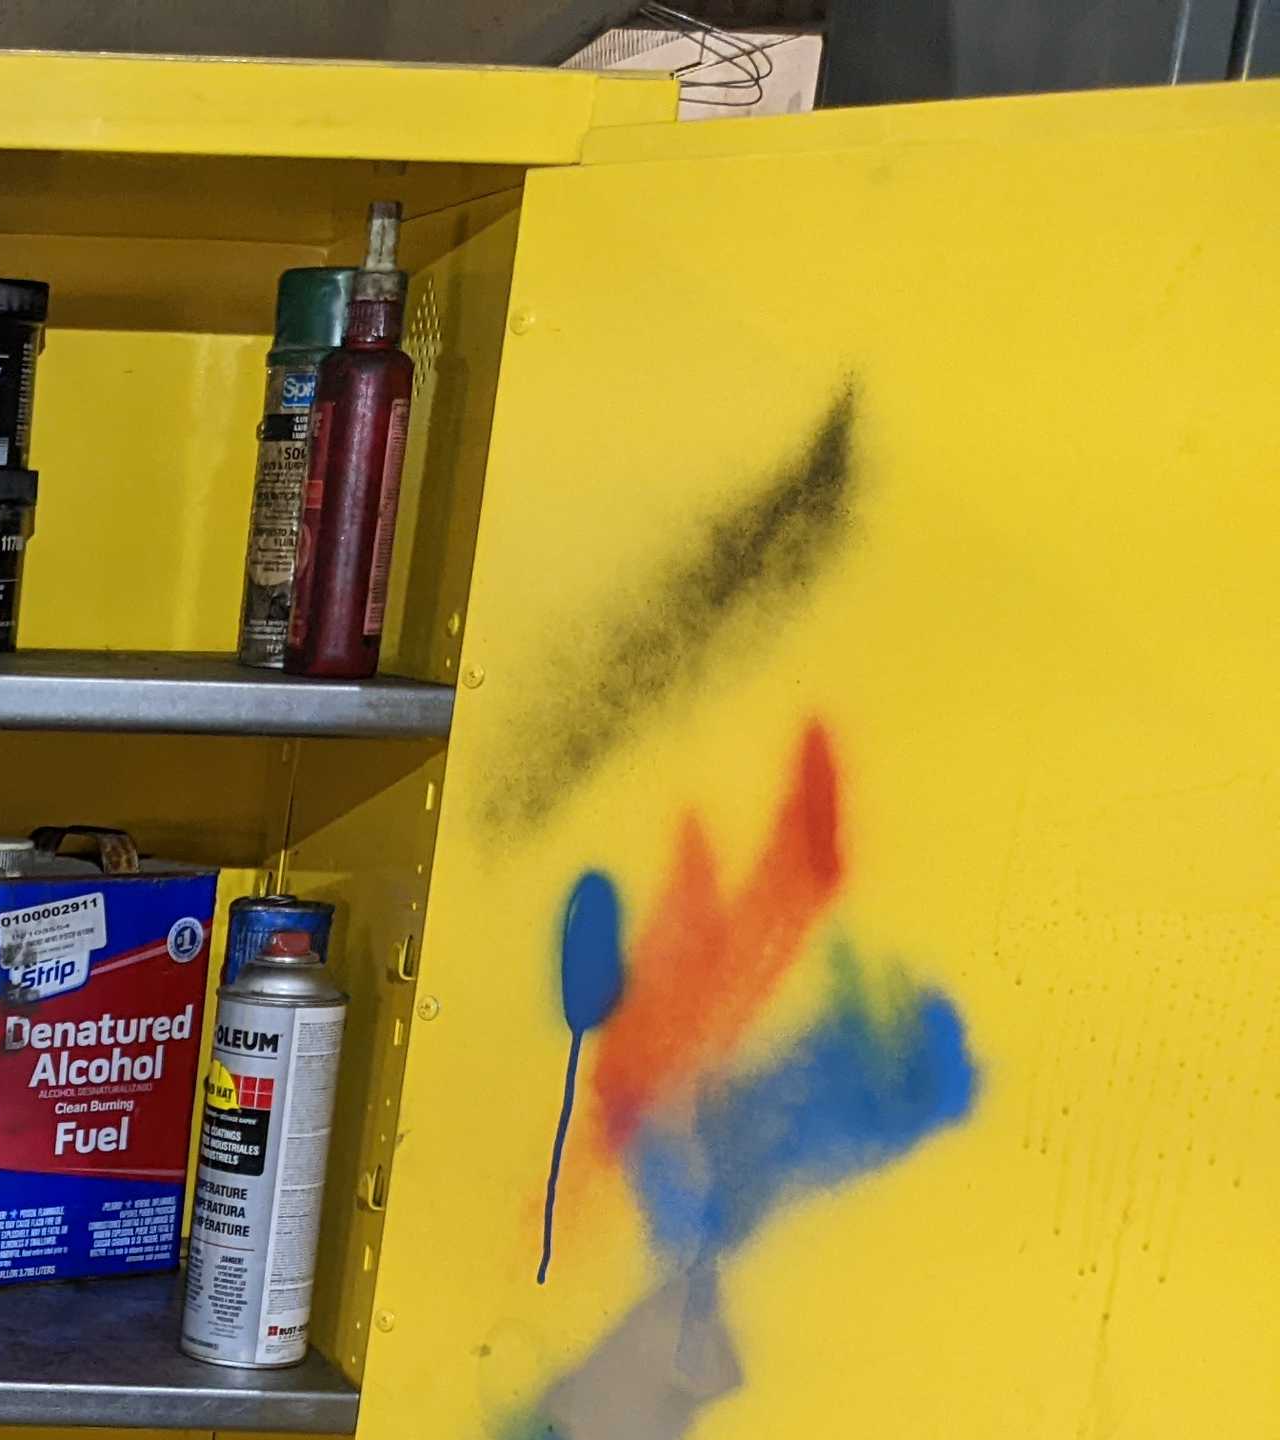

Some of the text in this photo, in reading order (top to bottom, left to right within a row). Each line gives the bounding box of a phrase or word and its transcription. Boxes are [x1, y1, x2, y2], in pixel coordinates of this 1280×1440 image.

[1, 897, 99, 928] 0100002911
[21, 960, 76, 990] Strip
[5, 1004, 193, 1051] Denatured
[28, 1045, 165, 1088] Alcohol
[39, 1088, 76, 1099] ALCOHOL
[55, 1099, 134, 1114] Clean Burning
[54, 1116, 129, 1155] Fuel
[210, 1126, 242, 1142] COATINGS
